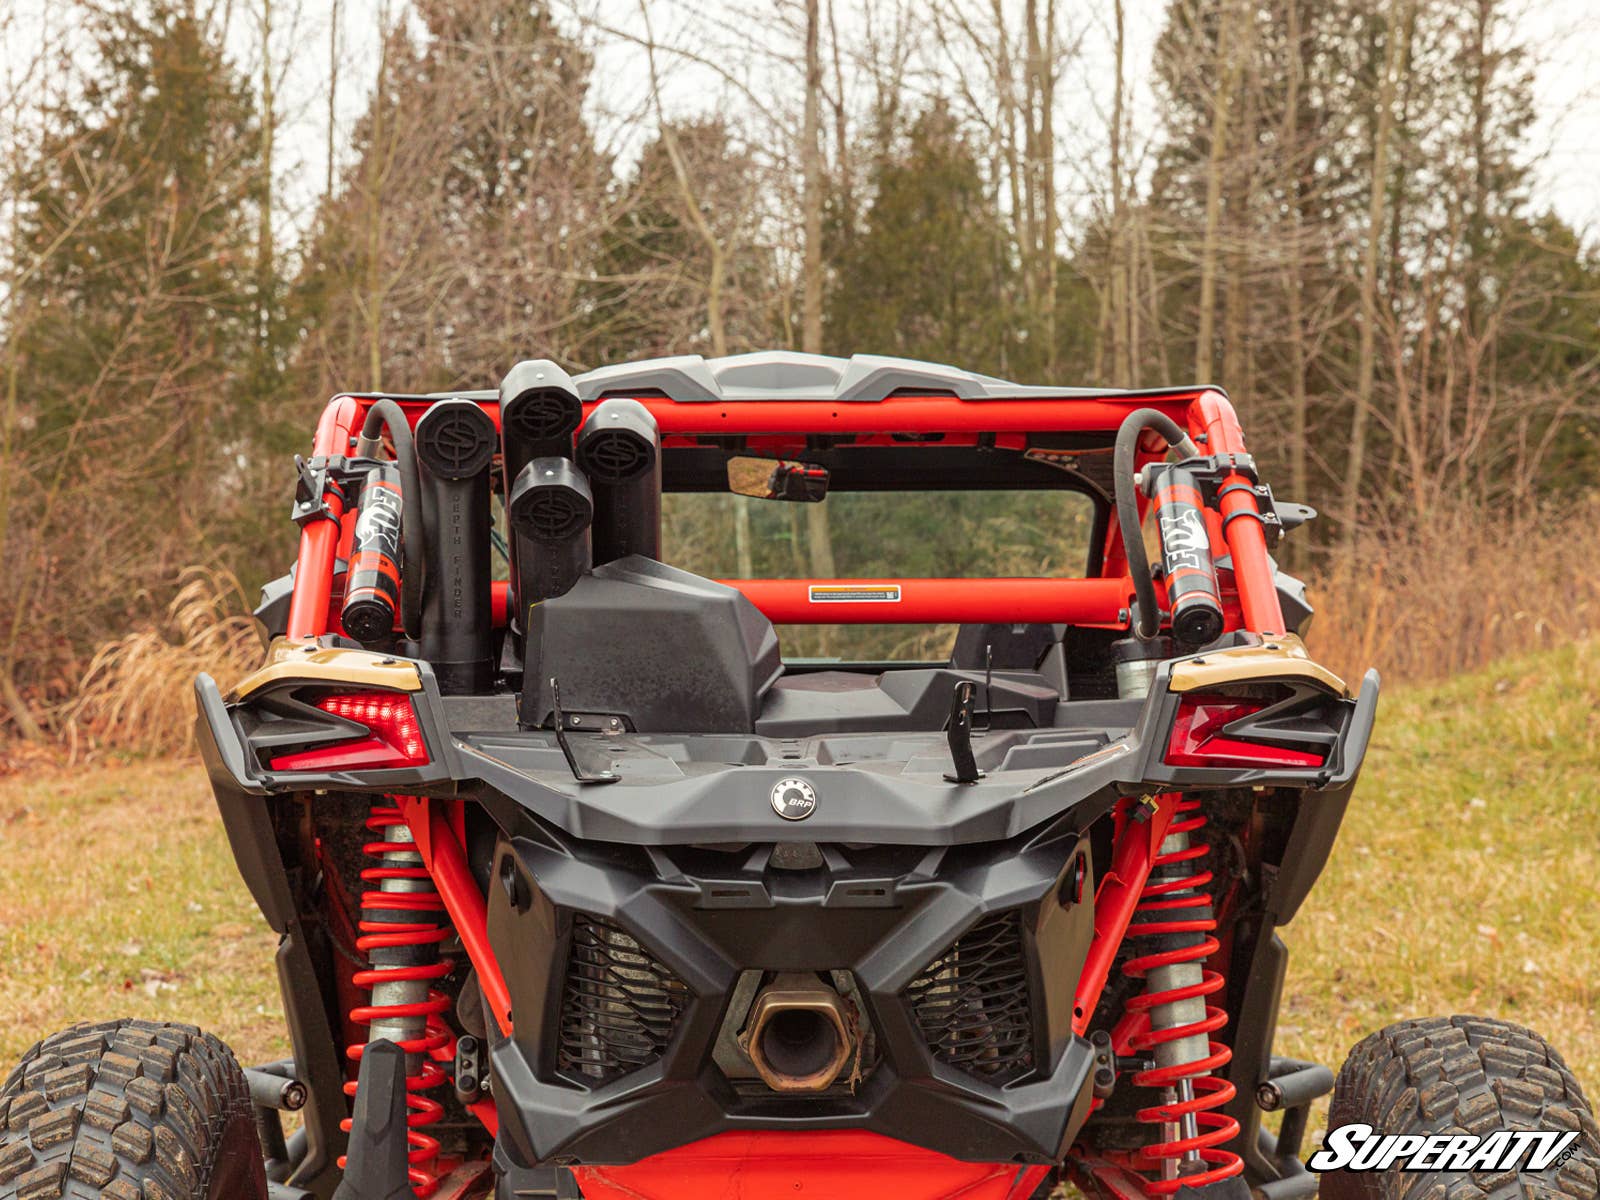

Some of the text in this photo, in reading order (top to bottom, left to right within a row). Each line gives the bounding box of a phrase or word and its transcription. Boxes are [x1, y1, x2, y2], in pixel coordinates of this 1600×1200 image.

[355, 486, 403, 554] FOX
[1160, 509, 1210, 573] FOX
[453, 495, 463, 618] DEPTH FINDER
[789, 798, 812, 808] BRP
